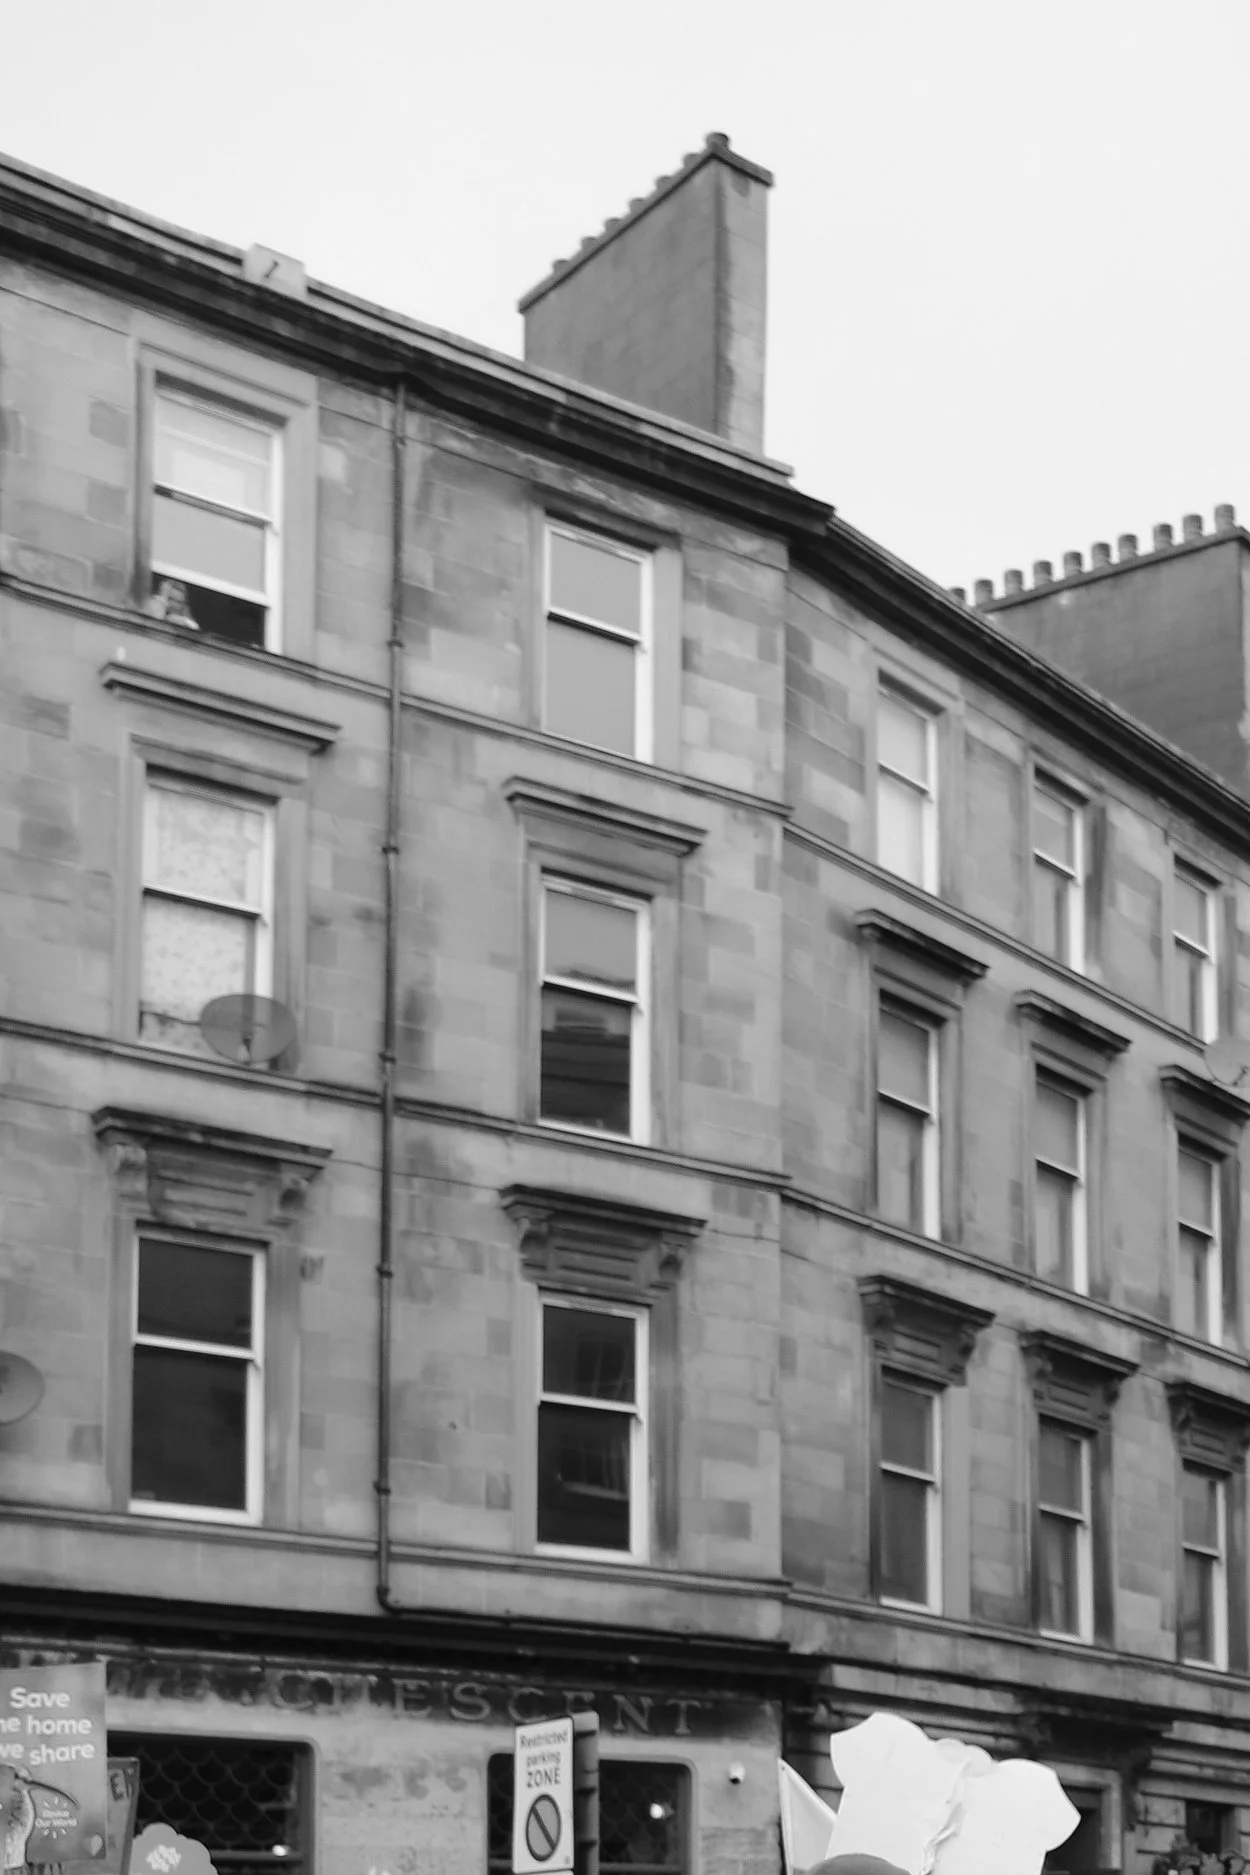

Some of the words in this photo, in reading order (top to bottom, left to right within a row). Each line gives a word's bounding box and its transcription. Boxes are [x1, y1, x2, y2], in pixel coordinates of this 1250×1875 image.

[10, 1687, 71, 1709] Save
[27, 1714, 93, 1735] home
[29, 1742, 96, 1766] share
[526, 1767, 561, 1789] ZONE
